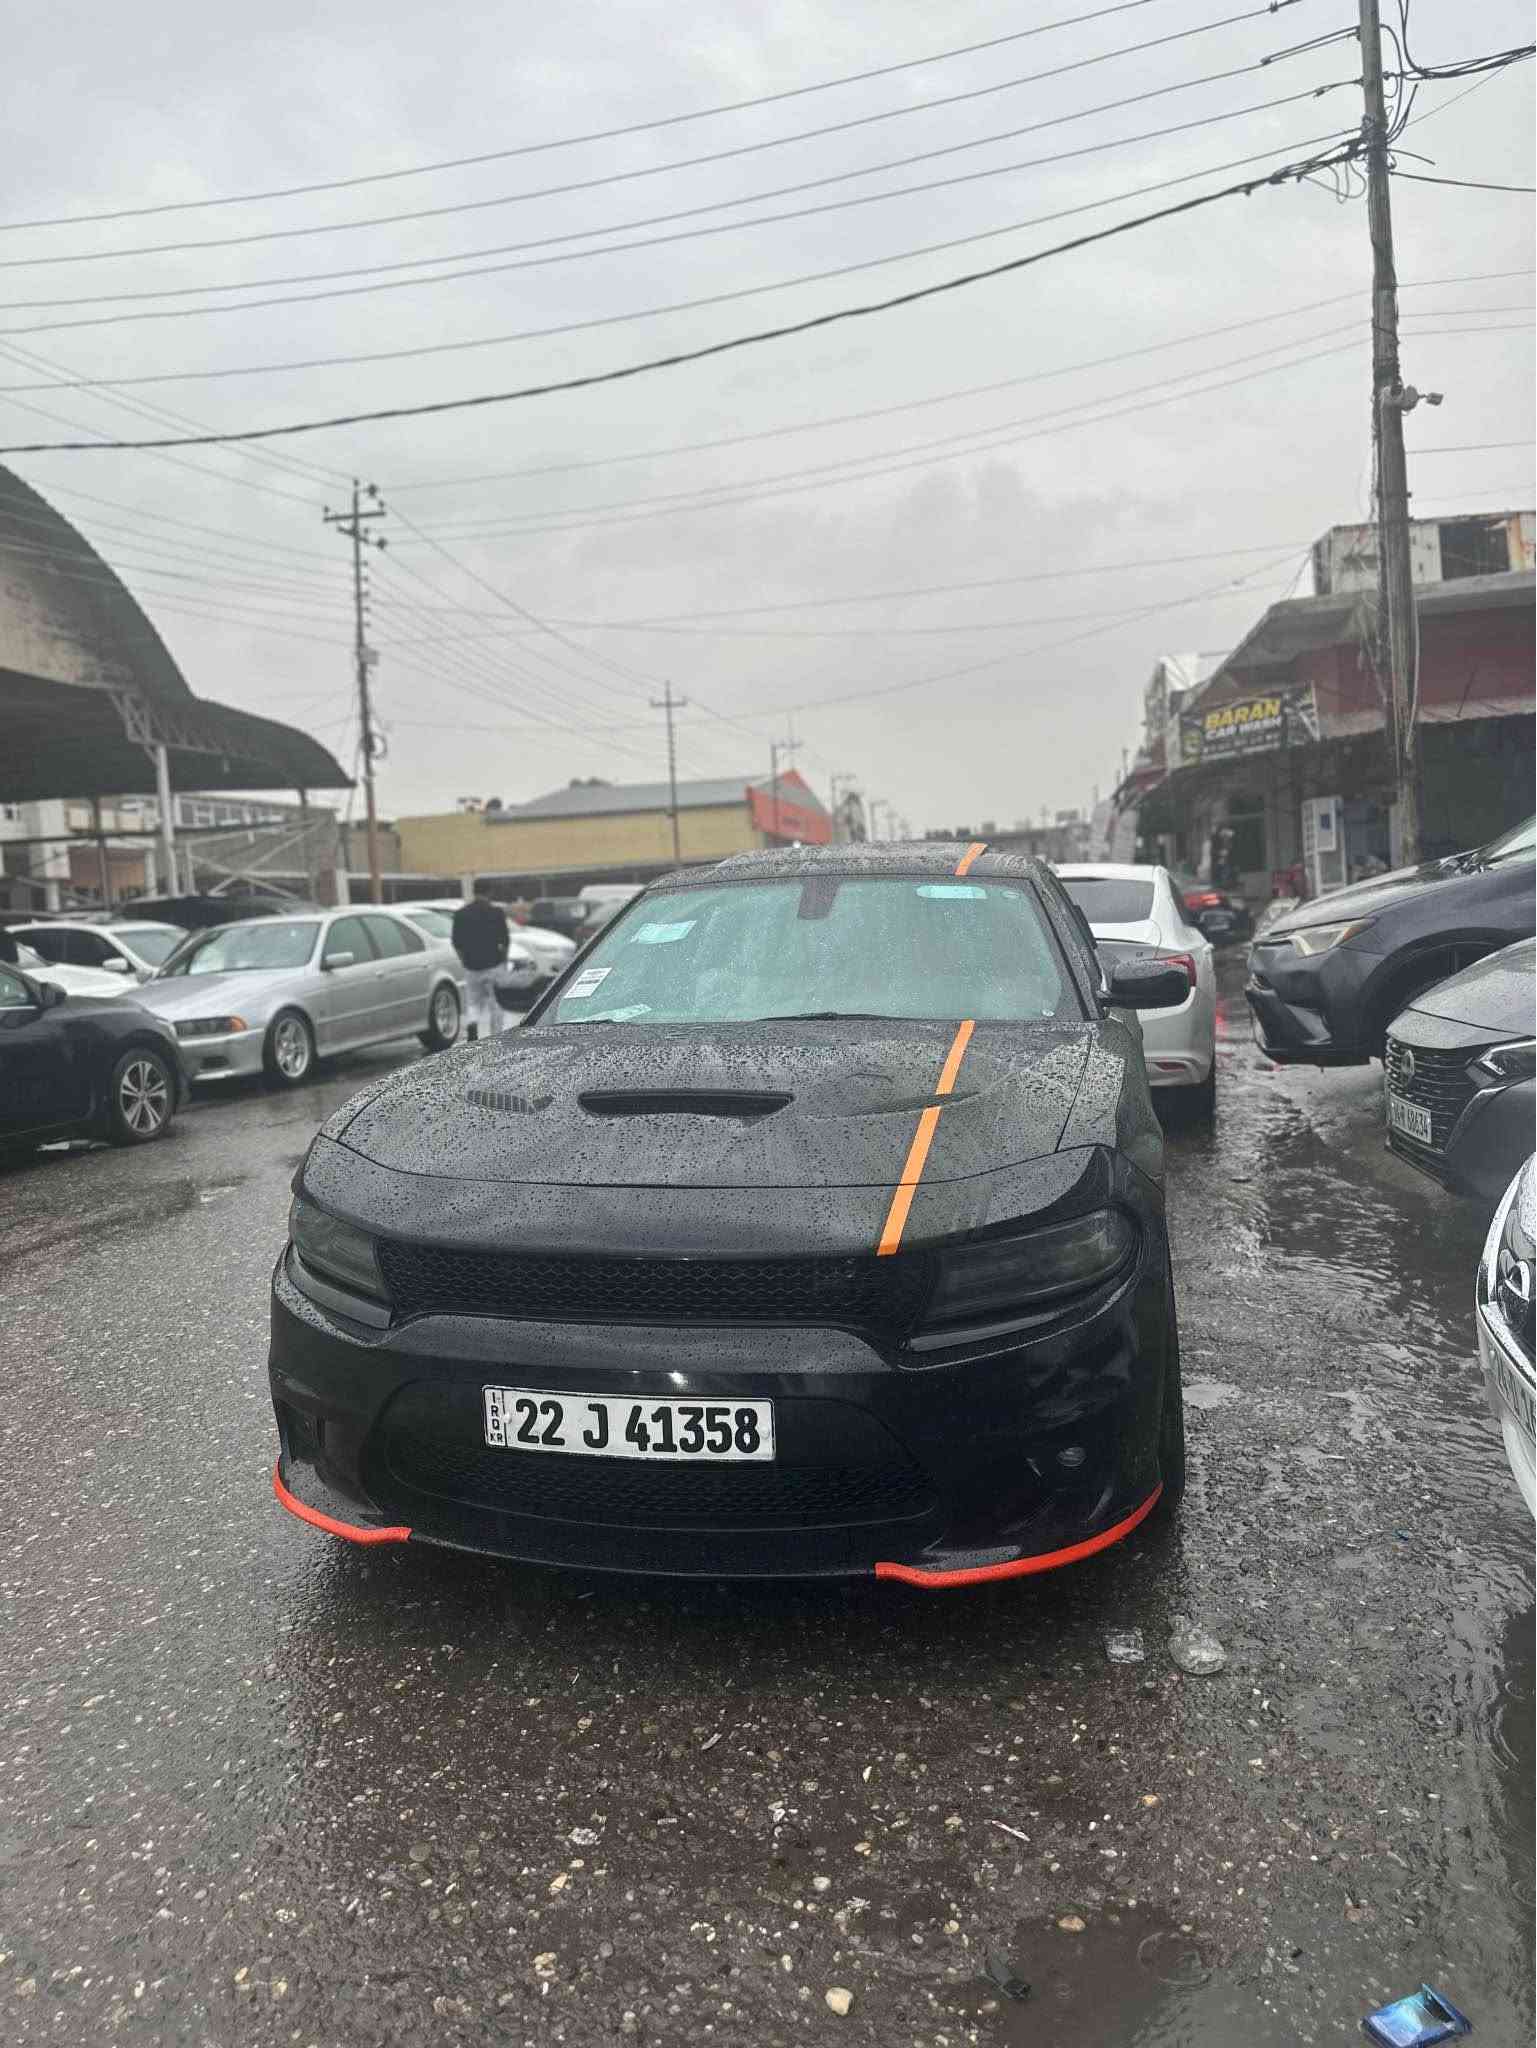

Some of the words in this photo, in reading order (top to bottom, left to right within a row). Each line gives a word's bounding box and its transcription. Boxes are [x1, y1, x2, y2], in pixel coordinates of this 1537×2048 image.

[1205, 699, 1281, 731] BARAN
[515, 1398, 566, 1447] 22
[582, 1402, 609, 1449] J
[624, 1404, 761, 1454] 41358
